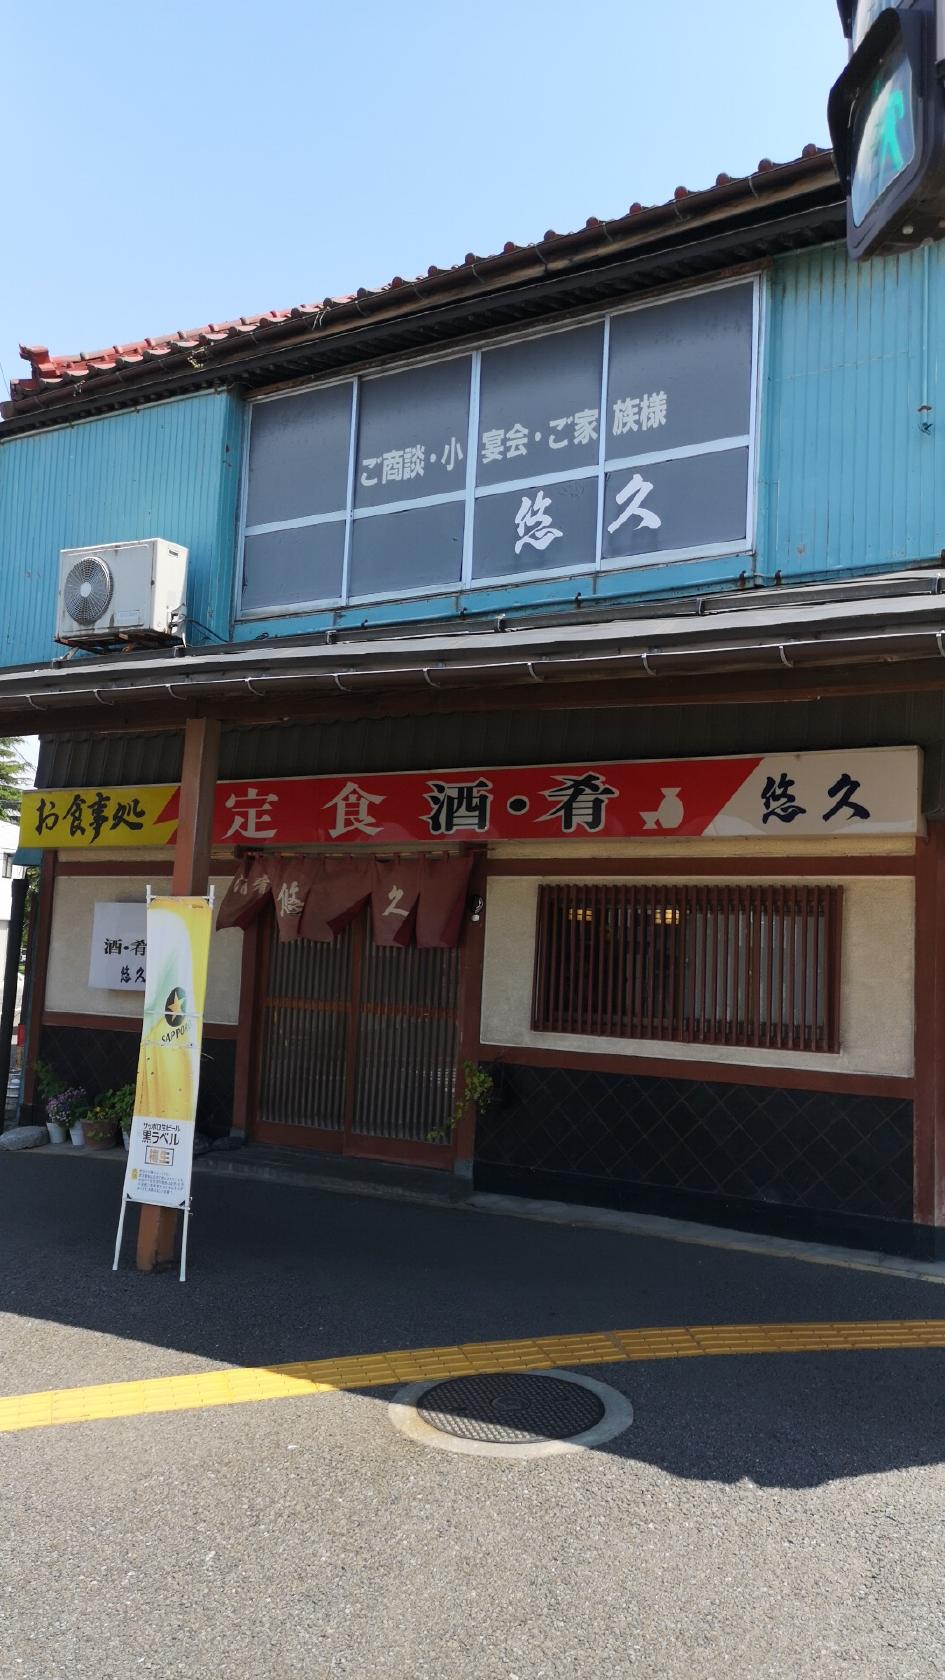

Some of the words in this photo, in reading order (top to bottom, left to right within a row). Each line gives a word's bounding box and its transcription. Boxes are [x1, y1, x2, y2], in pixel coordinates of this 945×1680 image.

[35, 792, 146, 844] お食事処
[760, 772, 871, 824] 悠久
[142, 1130, 180, 1146] 黒ラベル
